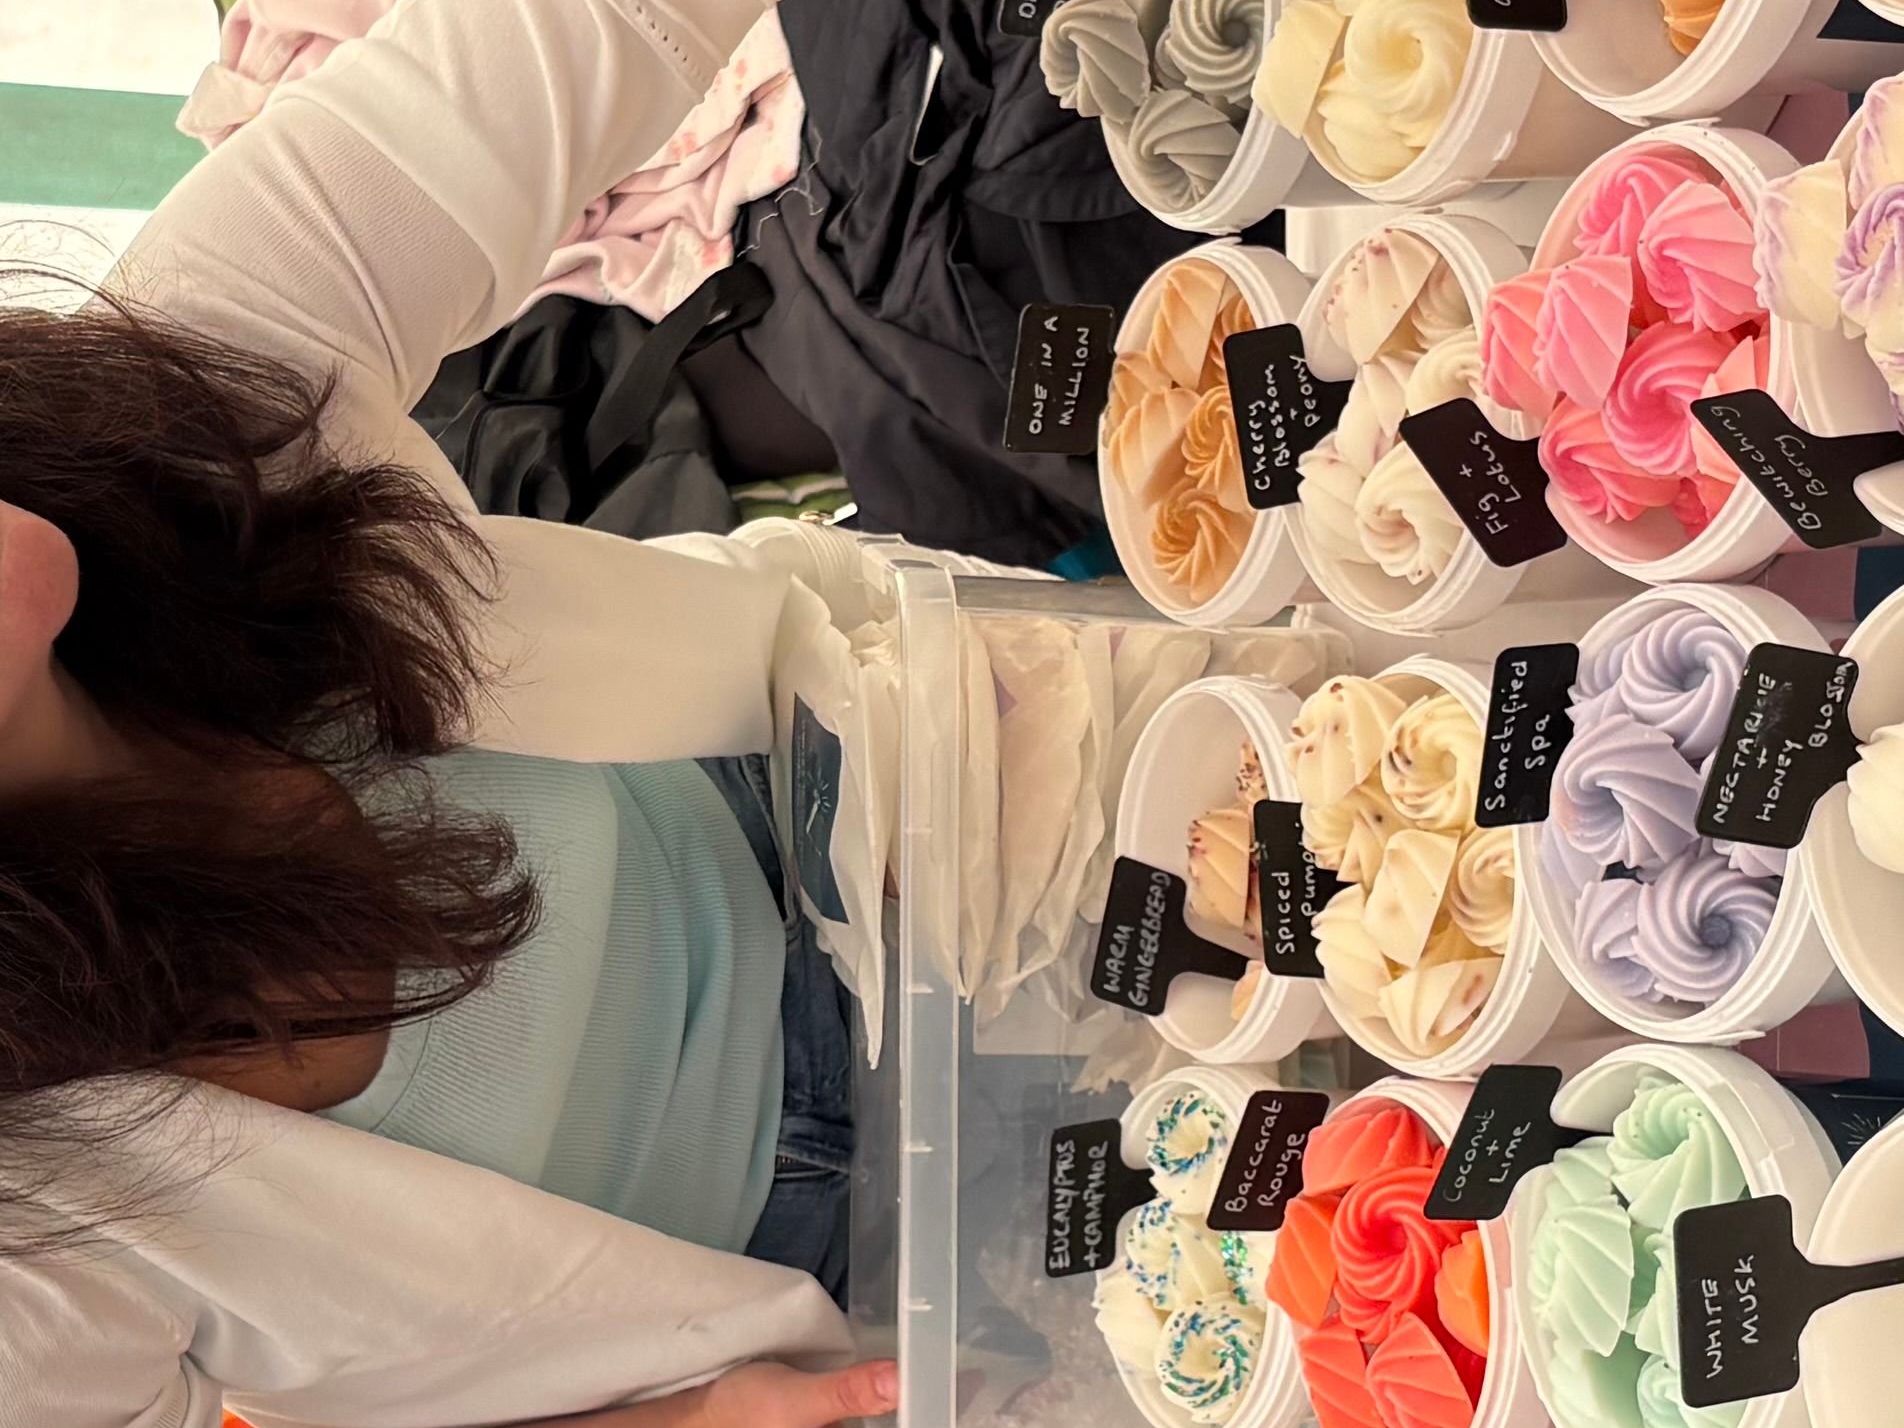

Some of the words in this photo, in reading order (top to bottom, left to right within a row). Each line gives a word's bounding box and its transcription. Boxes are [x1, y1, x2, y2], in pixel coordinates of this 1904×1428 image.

[1040, 341, 1054, 367] IN
[1043, 315, 1057, 331] A
[1029, 384, 1047, 434] ONE
[1058, 326, 1090, 426] MILLION
[1248, 400, 1270, 490] Cherry
[1469, 430, 1522, 502] Lotus
[1709, 404, 1821, 530] Bewitching
[1773, 435, 1829, 496] Berry
[1475, 493, 1509, 534] Fig
[1485, 660, 1530, 812] Sanctified
[1525, 714, 1551, 770] Spa
[1756, 739, 1803, 821] HONEY
[1128, 871, 1171, 1007] GINGERBREAD
[1271, 871, 1295, 954] Spiced
[1103, 924, 1133, 993] WARM
[1225, 1098, 1283, 1213] Baccarat
[1259, 1133, 1307, 1206] Rouge
[1442, 1108, 1495, 1203] Coconut
[1489, 1121, 1531, 1183] Lime
[1049, 1138, 1077, 1270] EUCALYPTUS
[1702, 1278, 1725, 1379] WHITE
[1736, 1254, 1759, 1344] MUSK
